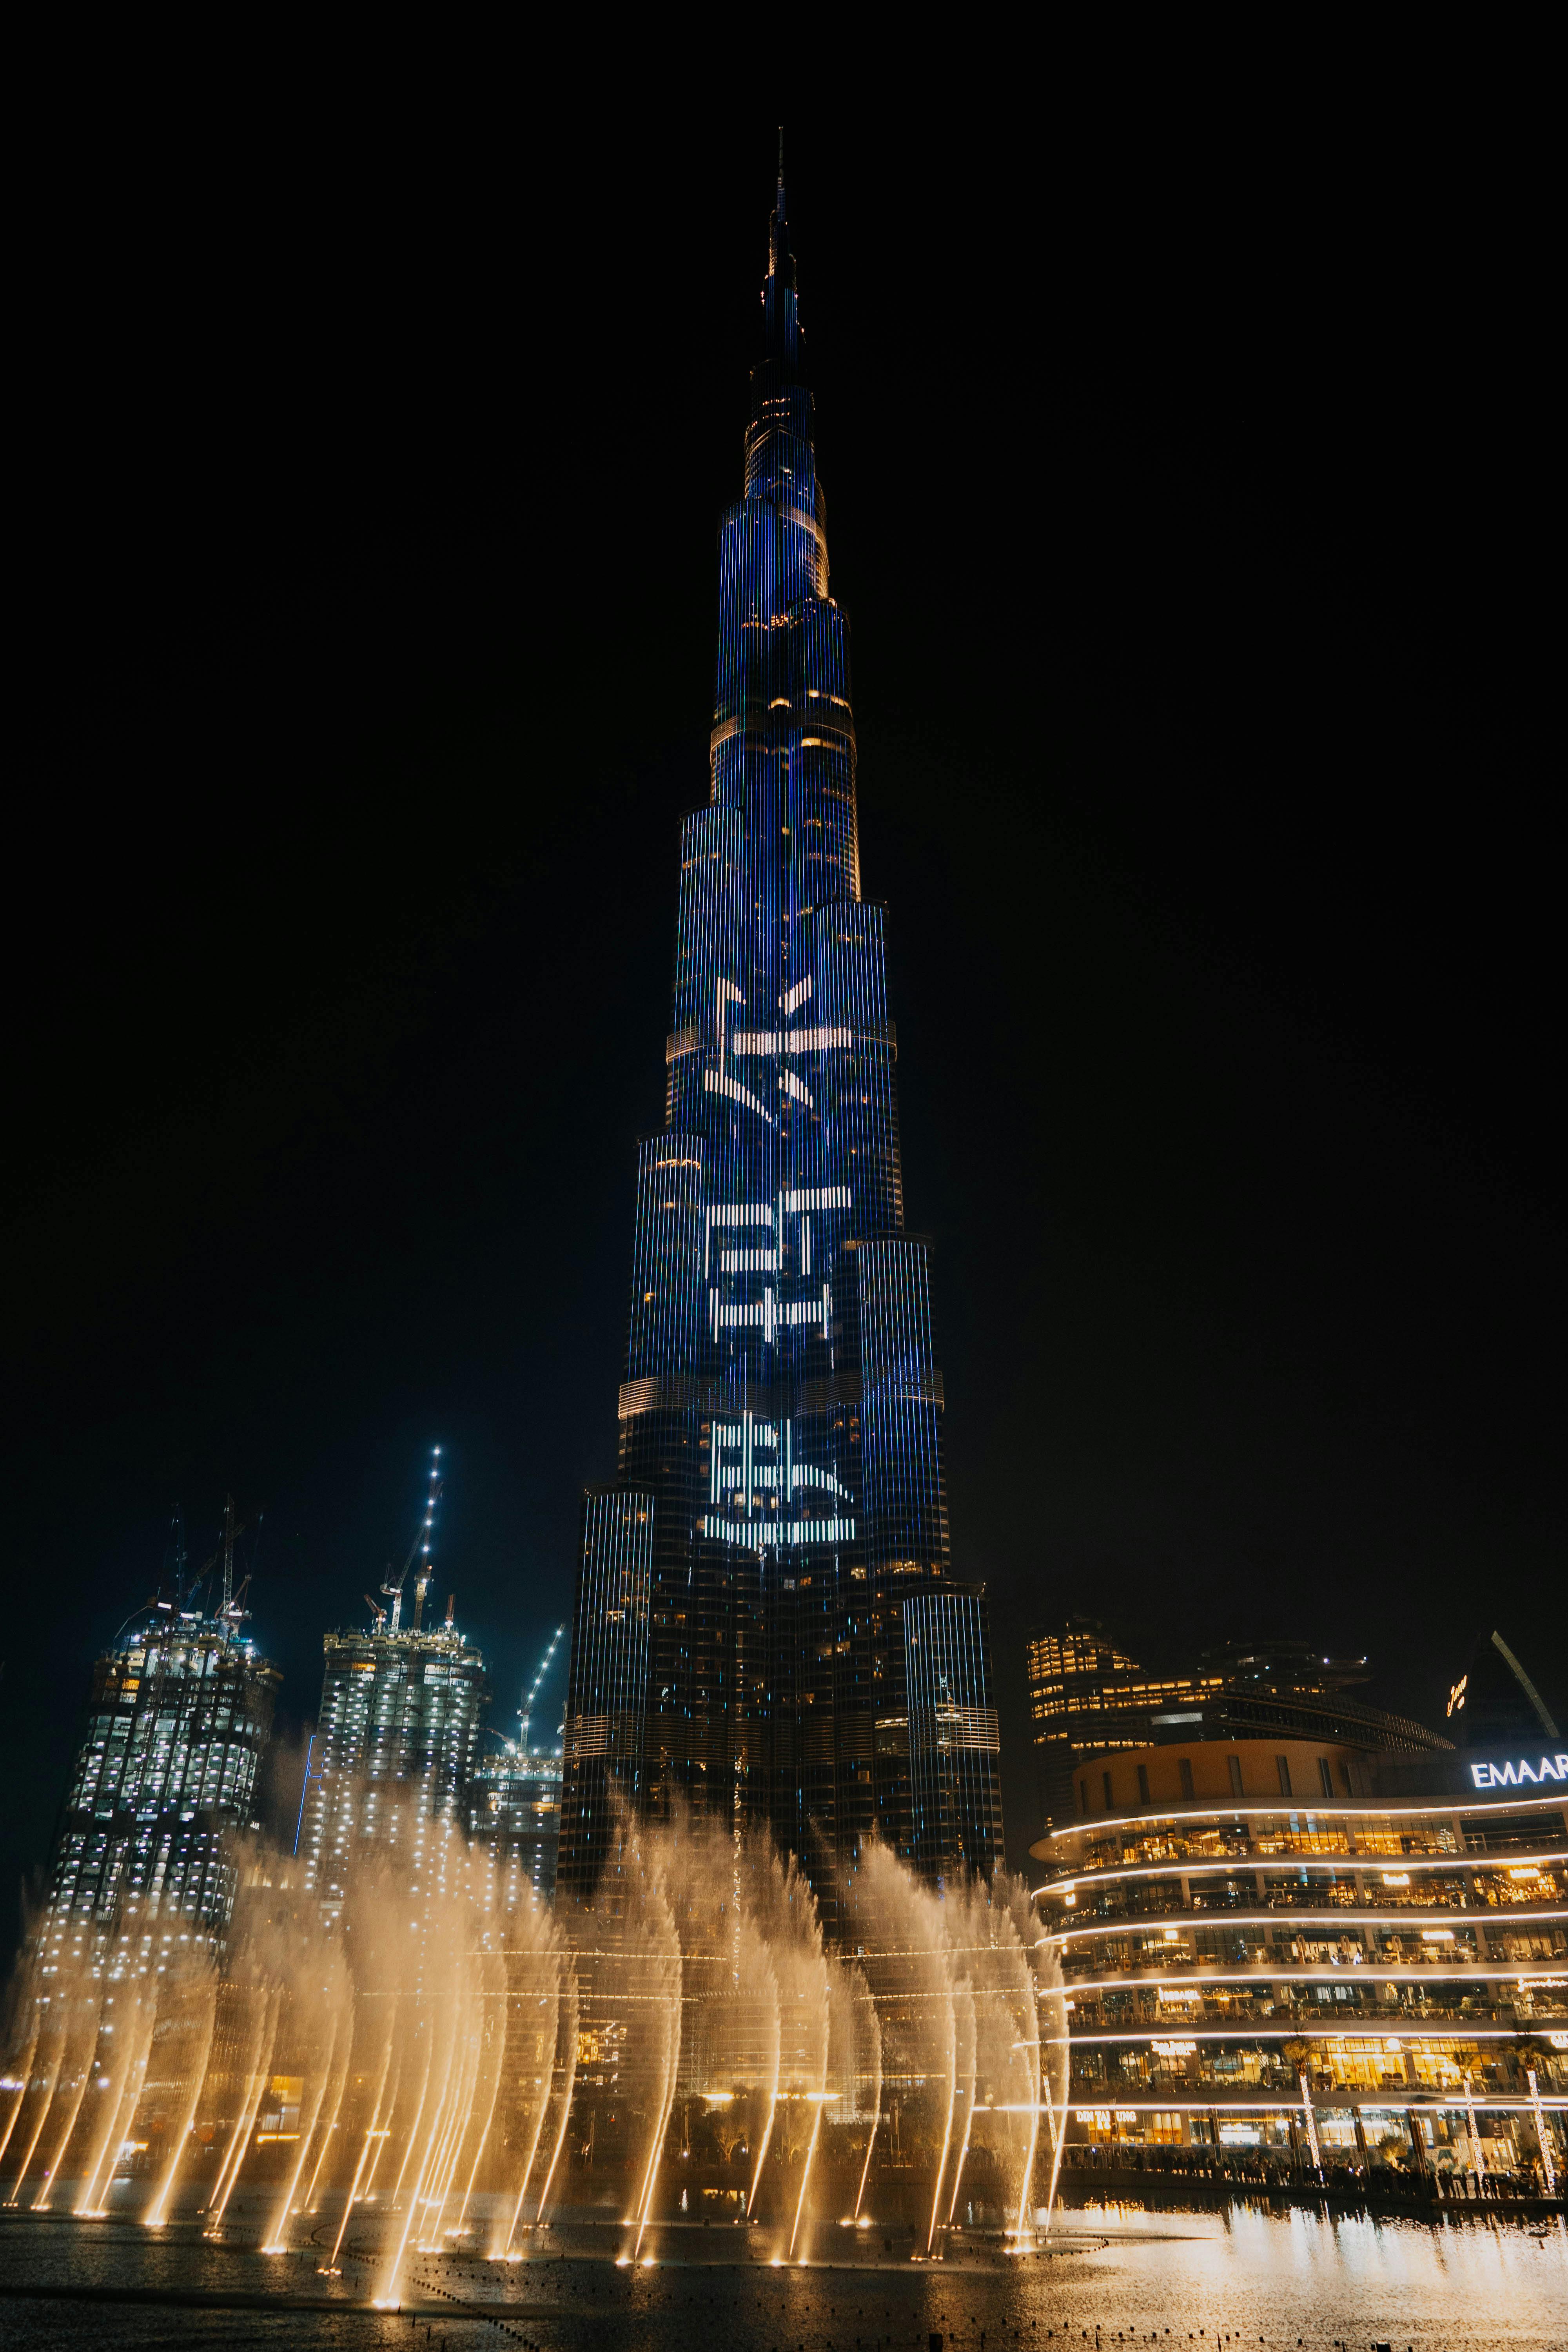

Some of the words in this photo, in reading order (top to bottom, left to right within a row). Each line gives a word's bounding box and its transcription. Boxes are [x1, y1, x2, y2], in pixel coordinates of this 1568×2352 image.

[1471, 1755, 1568, 1788] EMAAR
[1076, 2111, 1094, 2122] DIN
[1094, 2111, 1111, 2122] TAI
[1116, 2111, 1136, 2122] UNG
